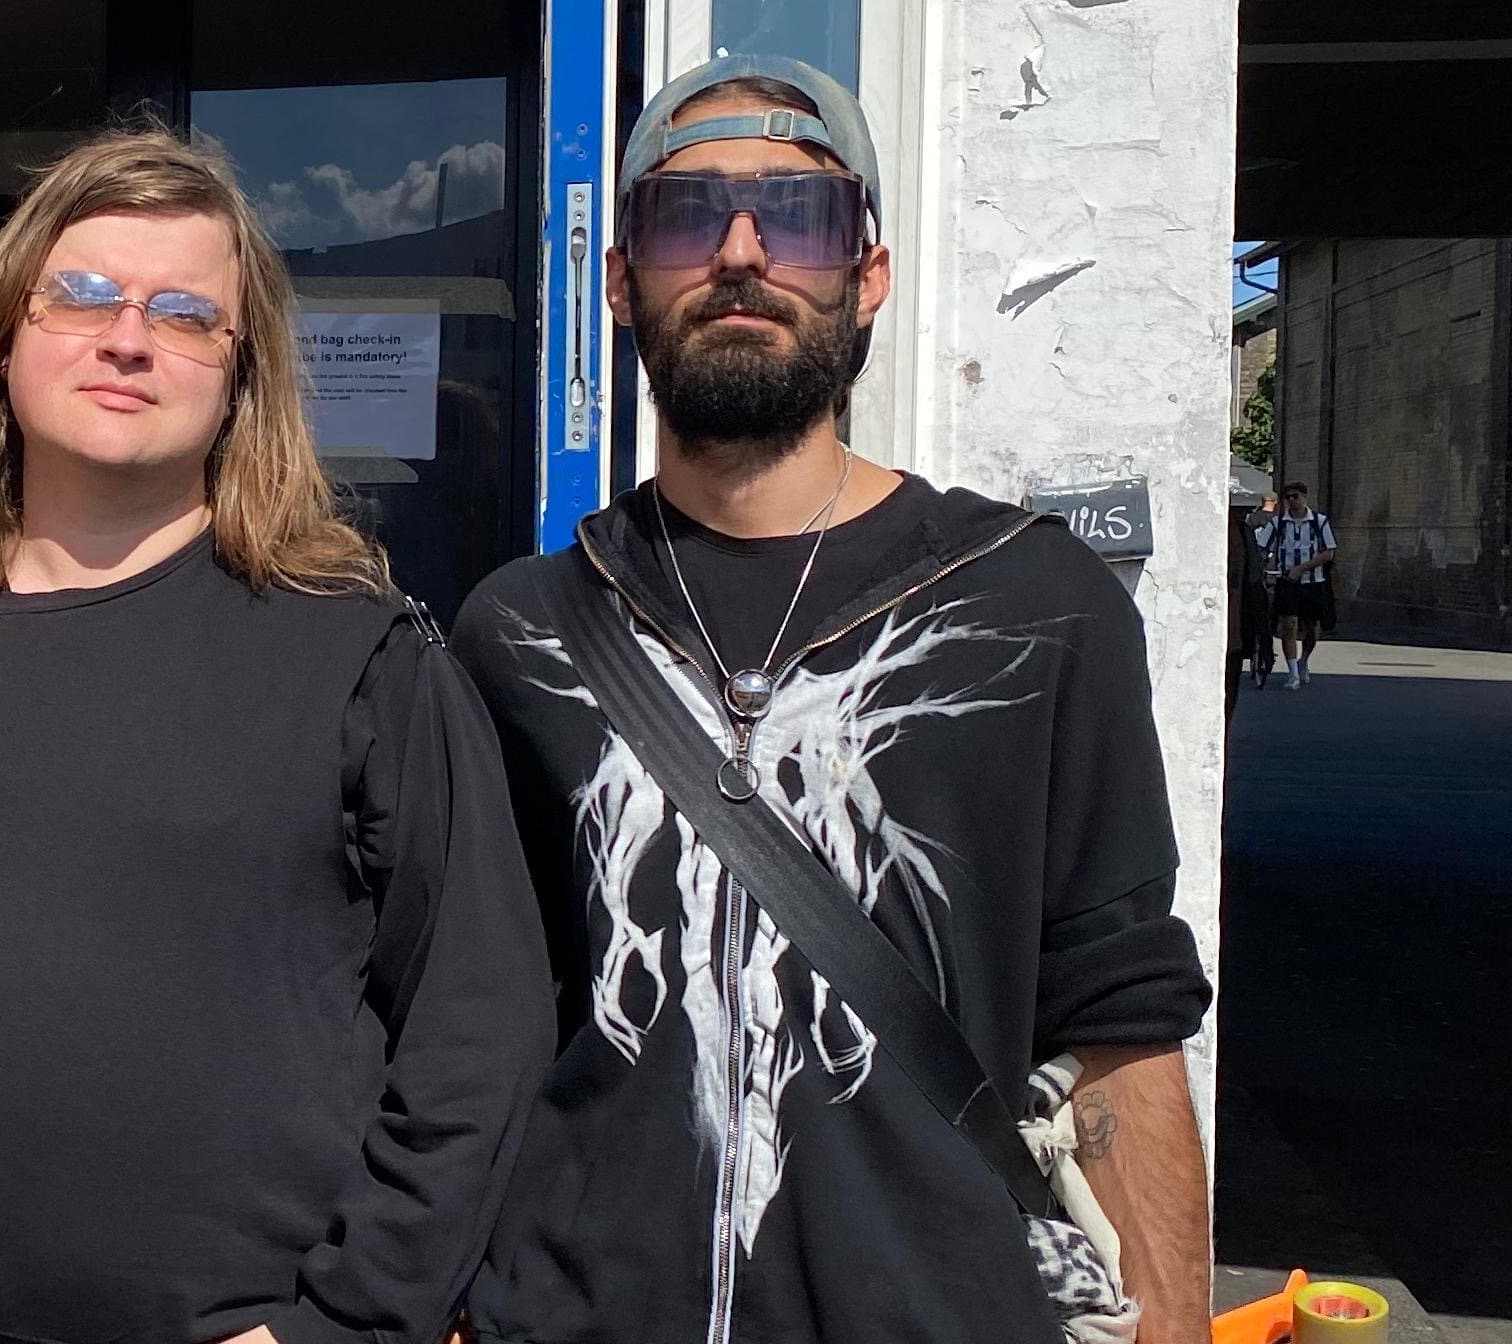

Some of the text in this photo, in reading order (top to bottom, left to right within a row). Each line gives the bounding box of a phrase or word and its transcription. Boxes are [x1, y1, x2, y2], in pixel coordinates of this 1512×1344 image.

[321, 333, 343, 348] bag
[347, 333, 401, 345] check-in
[320, 352, 332, 363] is
[334, 351, 407, 365] mandatory!
